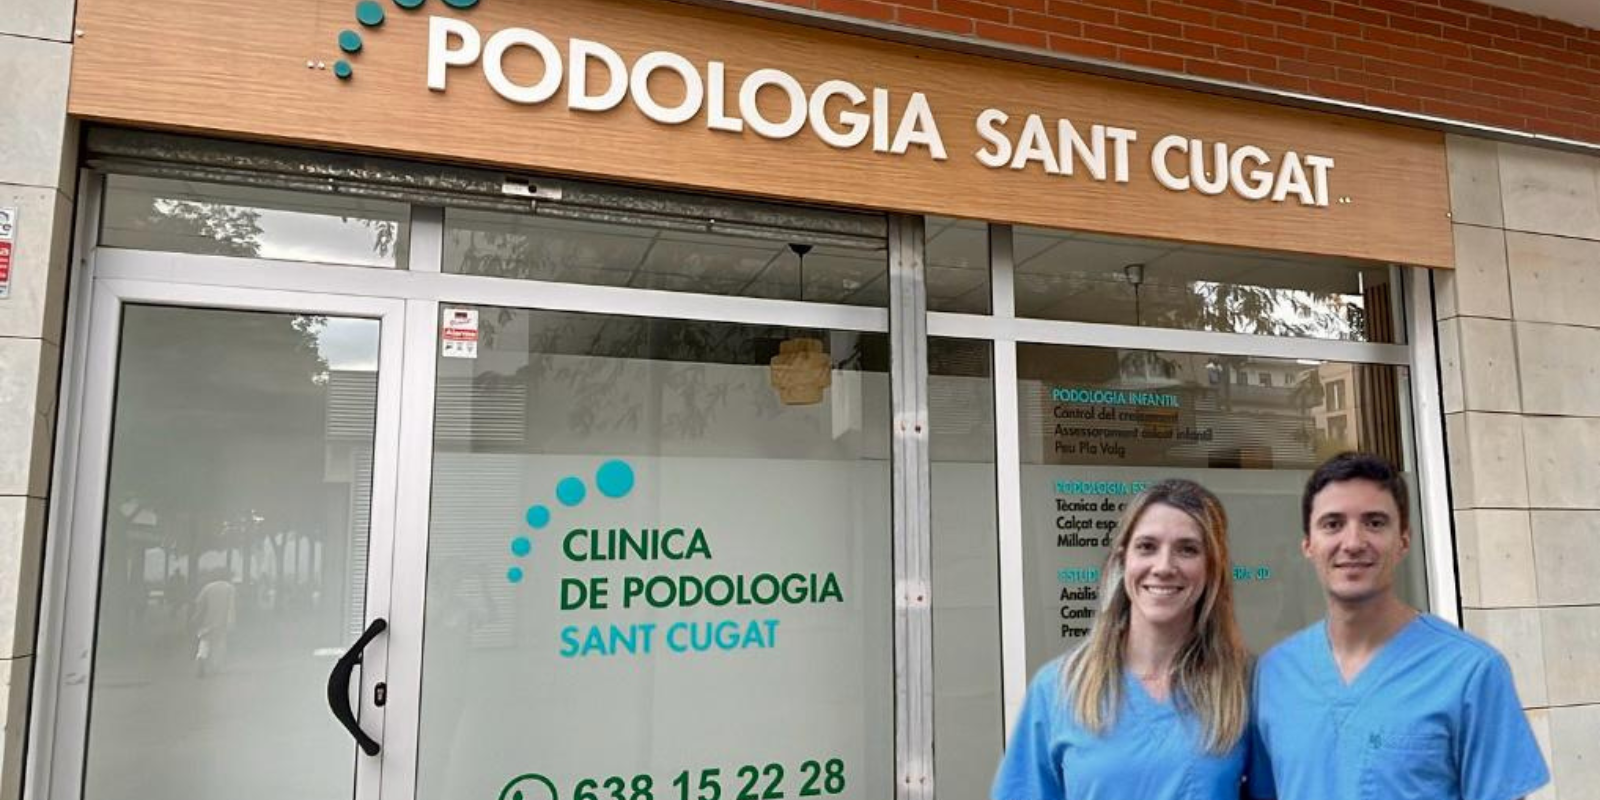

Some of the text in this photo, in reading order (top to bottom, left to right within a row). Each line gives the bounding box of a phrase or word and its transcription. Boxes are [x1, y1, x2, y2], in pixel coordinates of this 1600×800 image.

[427, 15, 1335, 207] PODOLOGIA SANT CUGAT
[1053, 388, 1180, 408] PODOLOGIA INFANTIL
[1053, 406, 1095, 419] Control
[1098, 407, 1116, 420] del
[1055, 441, 1075, 454] Peu
[1080, 441, 1098, 455] Pla
[1056, 481, 1127, 496] PODOLOGIA
[1056, 498, 1098, 511] Tècnica
[1101, 498, 1116, 511] de
[1056, 515, 1093, 531] Calçat
[562, 528, 712, 561] CLINICA
[1057, 533, 1099, 547] Millora
[560, 572, 844, 611] DE PODOLOGIA
[1061, 605, 1097, 619] Contr
[559, 619, 780, 658] SANT CUGAT
[1061, 624, 1091, 638] Prev
[573, 758, 846, 800] 638 15 22 28
